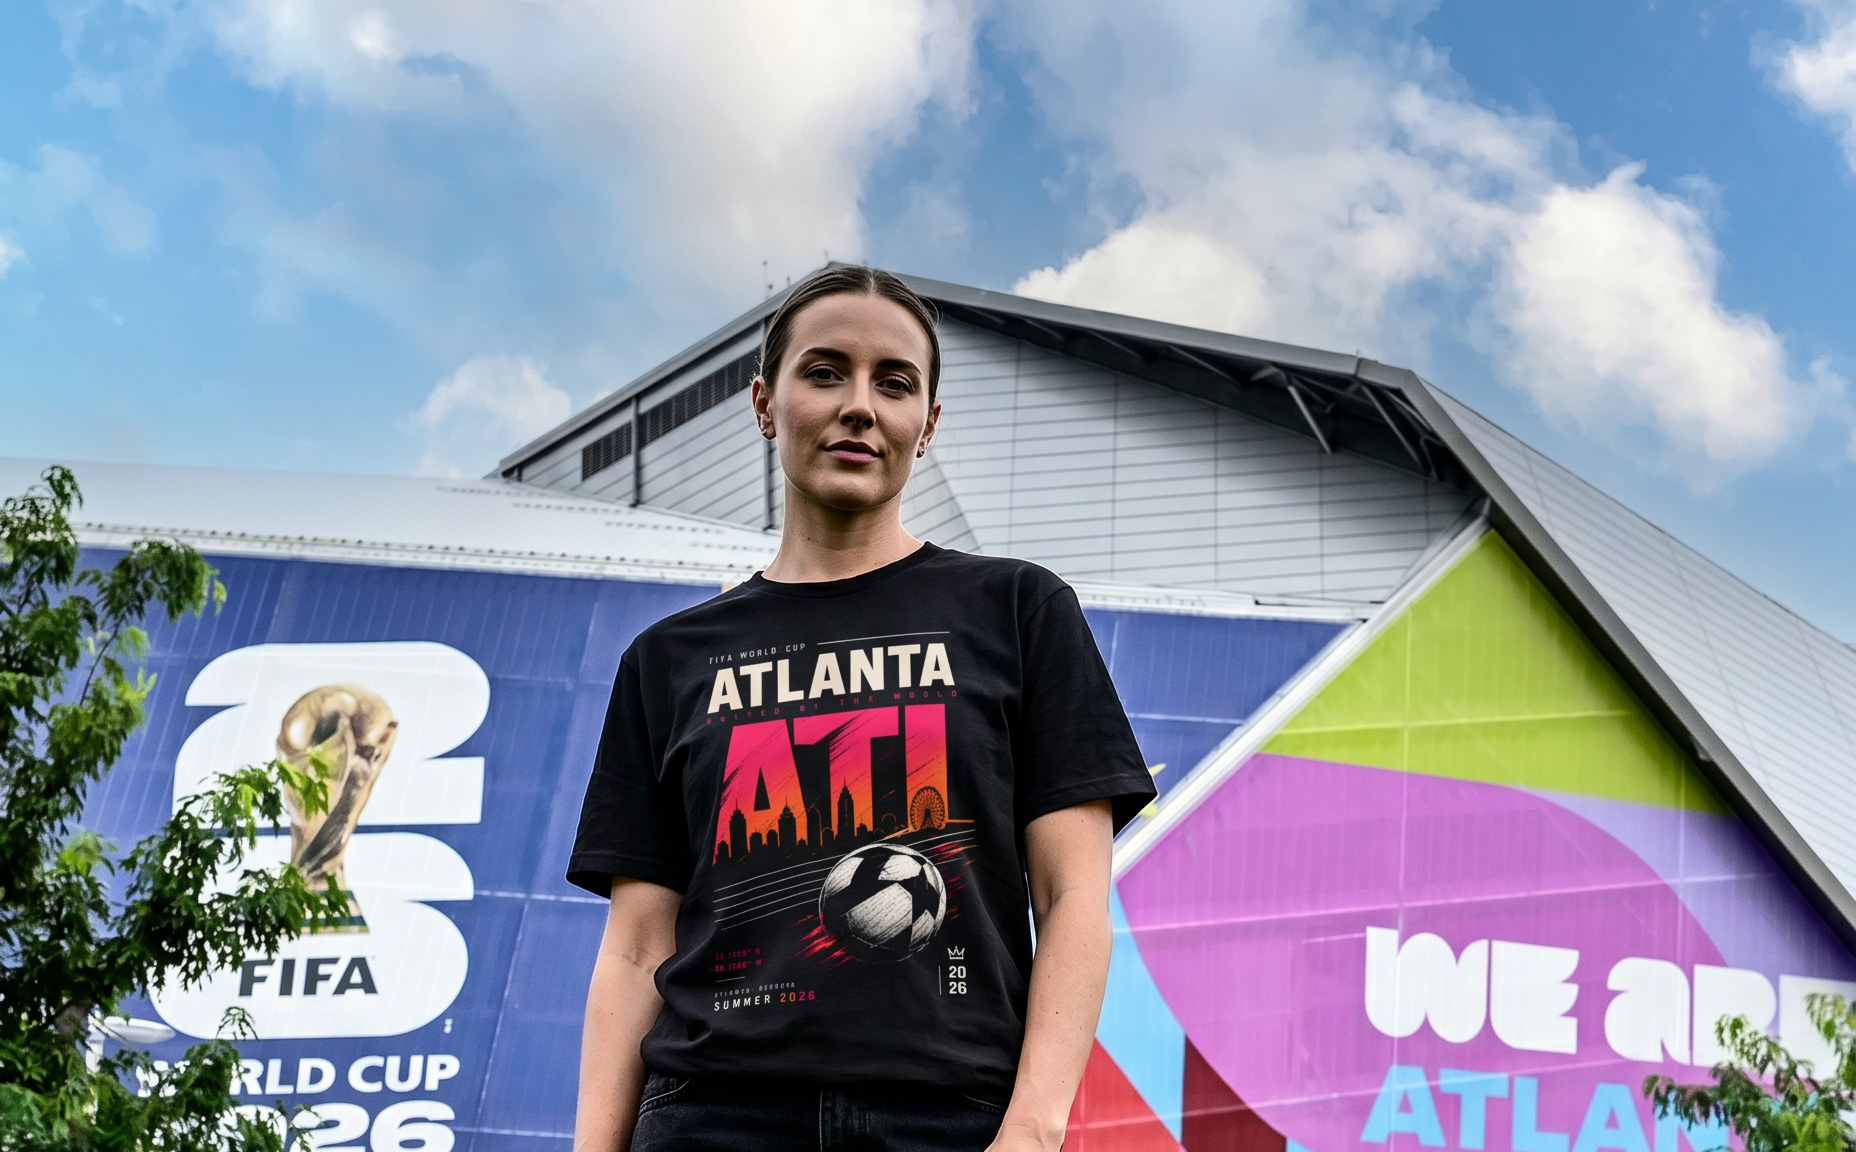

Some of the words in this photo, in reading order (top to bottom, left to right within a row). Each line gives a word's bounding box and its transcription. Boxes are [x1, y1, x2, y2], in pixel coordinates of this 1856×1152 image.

[709, 654, 733, 665] FIFA
[740, 647, 777, 659] WORLD
[785, 643, 806, 653] CUP
[707, 642, 955, 714] ATLANTA
[238, 956, 378, 997] FIFA
[949, 966, 967, 978] 20
[714, 994, 771, 1012] SUMMER
[780, 990, 815, 1003] 2026
[949, 982, 967, 994] 26
[1365, 926, 1580, 1055] WE
[136, 1057, 337, 1098] RLD
[348, 1055, 461, 1093] CUP
